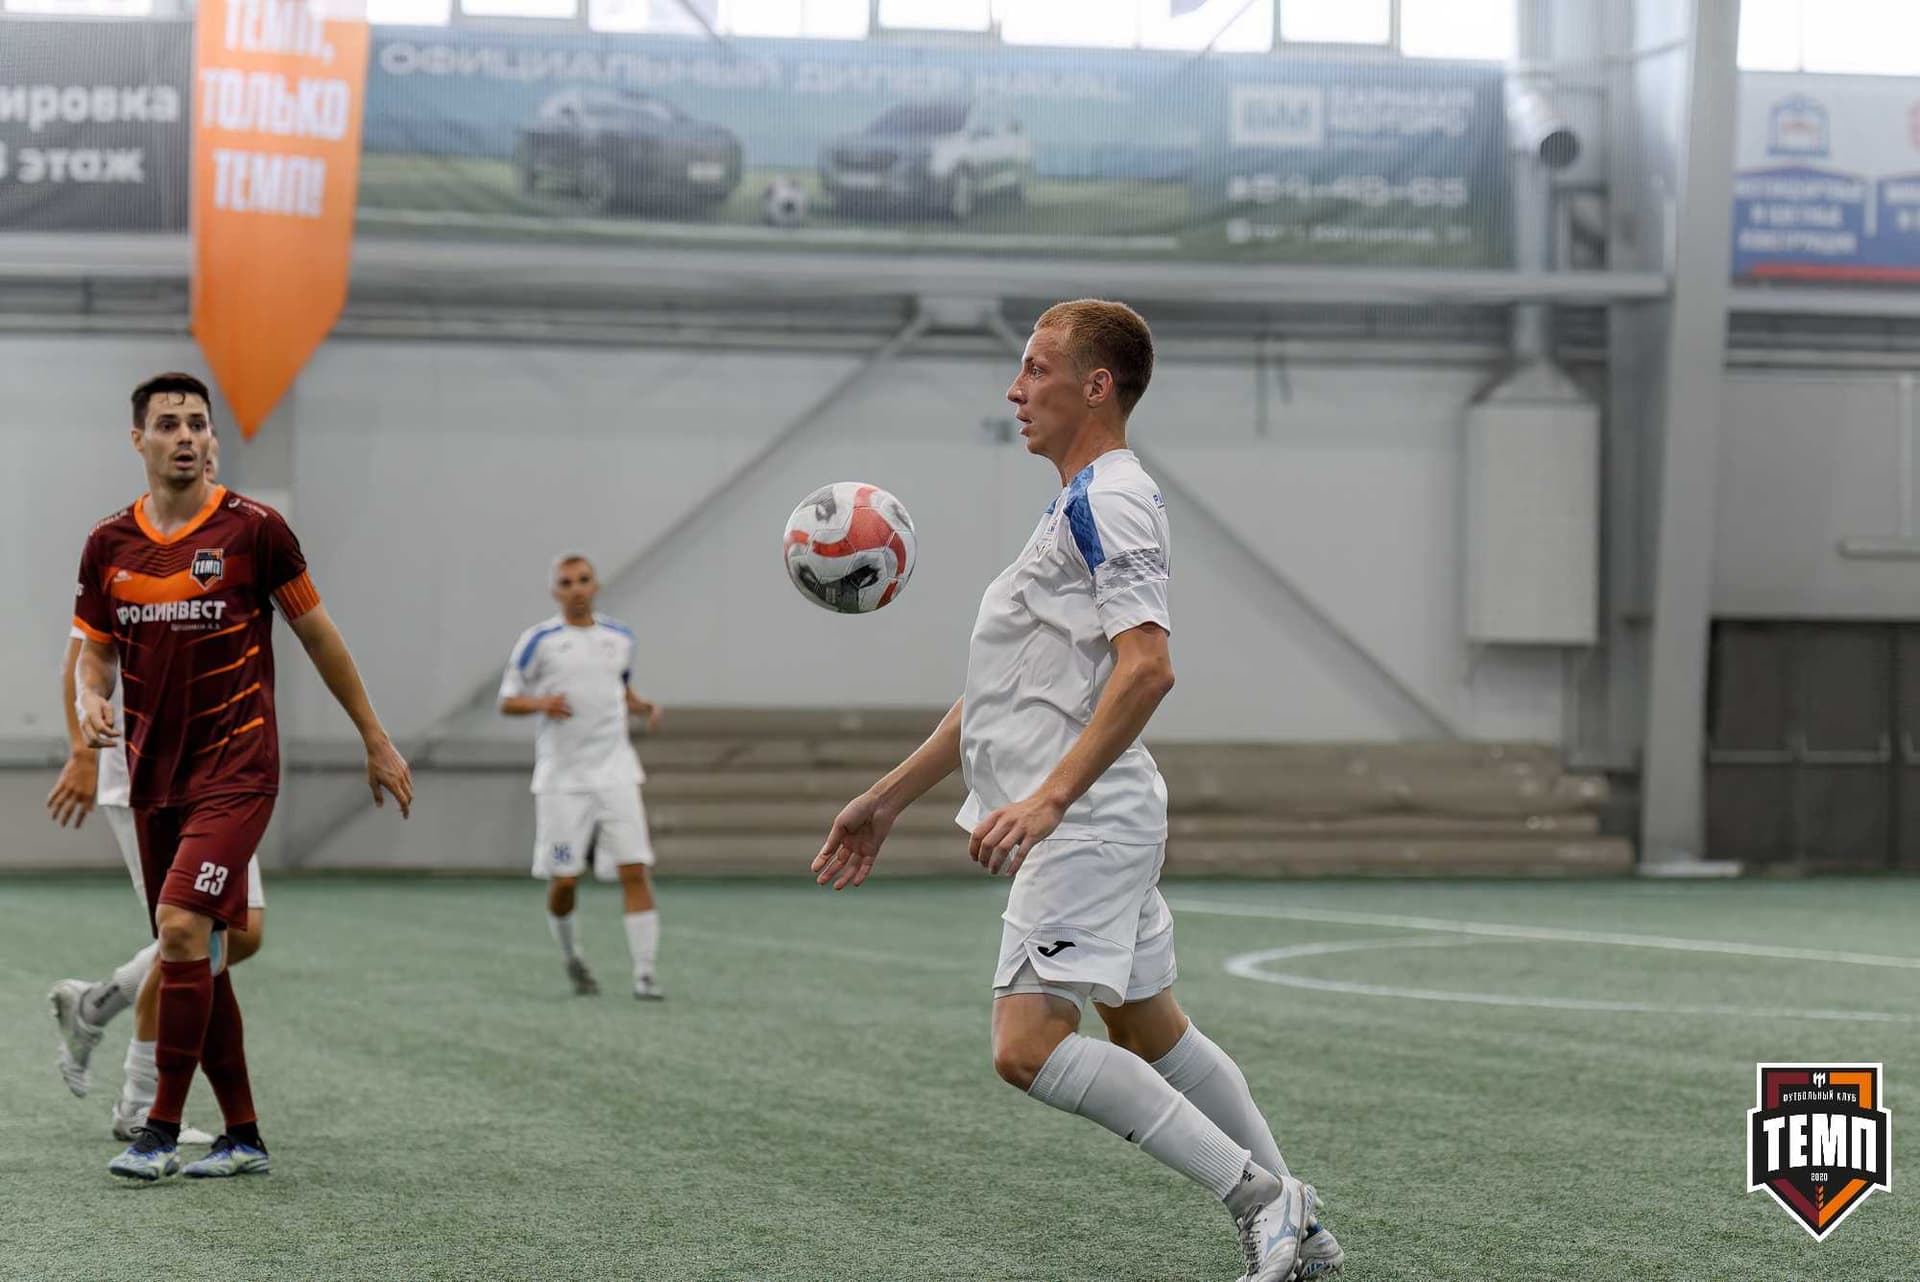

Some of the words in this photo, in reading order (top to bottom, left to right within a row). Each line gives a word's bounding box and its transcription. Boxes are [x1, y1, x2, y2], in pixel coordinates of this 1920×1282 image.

[202, 68, 349, 141] ТОЛЬКО
[18, 148, 145, 183] этаж
[213, 149, 326, 217] ТЕМП!
[194, 559, 221, 576] ТЕМП
[194, 861, 228, 896] 23
